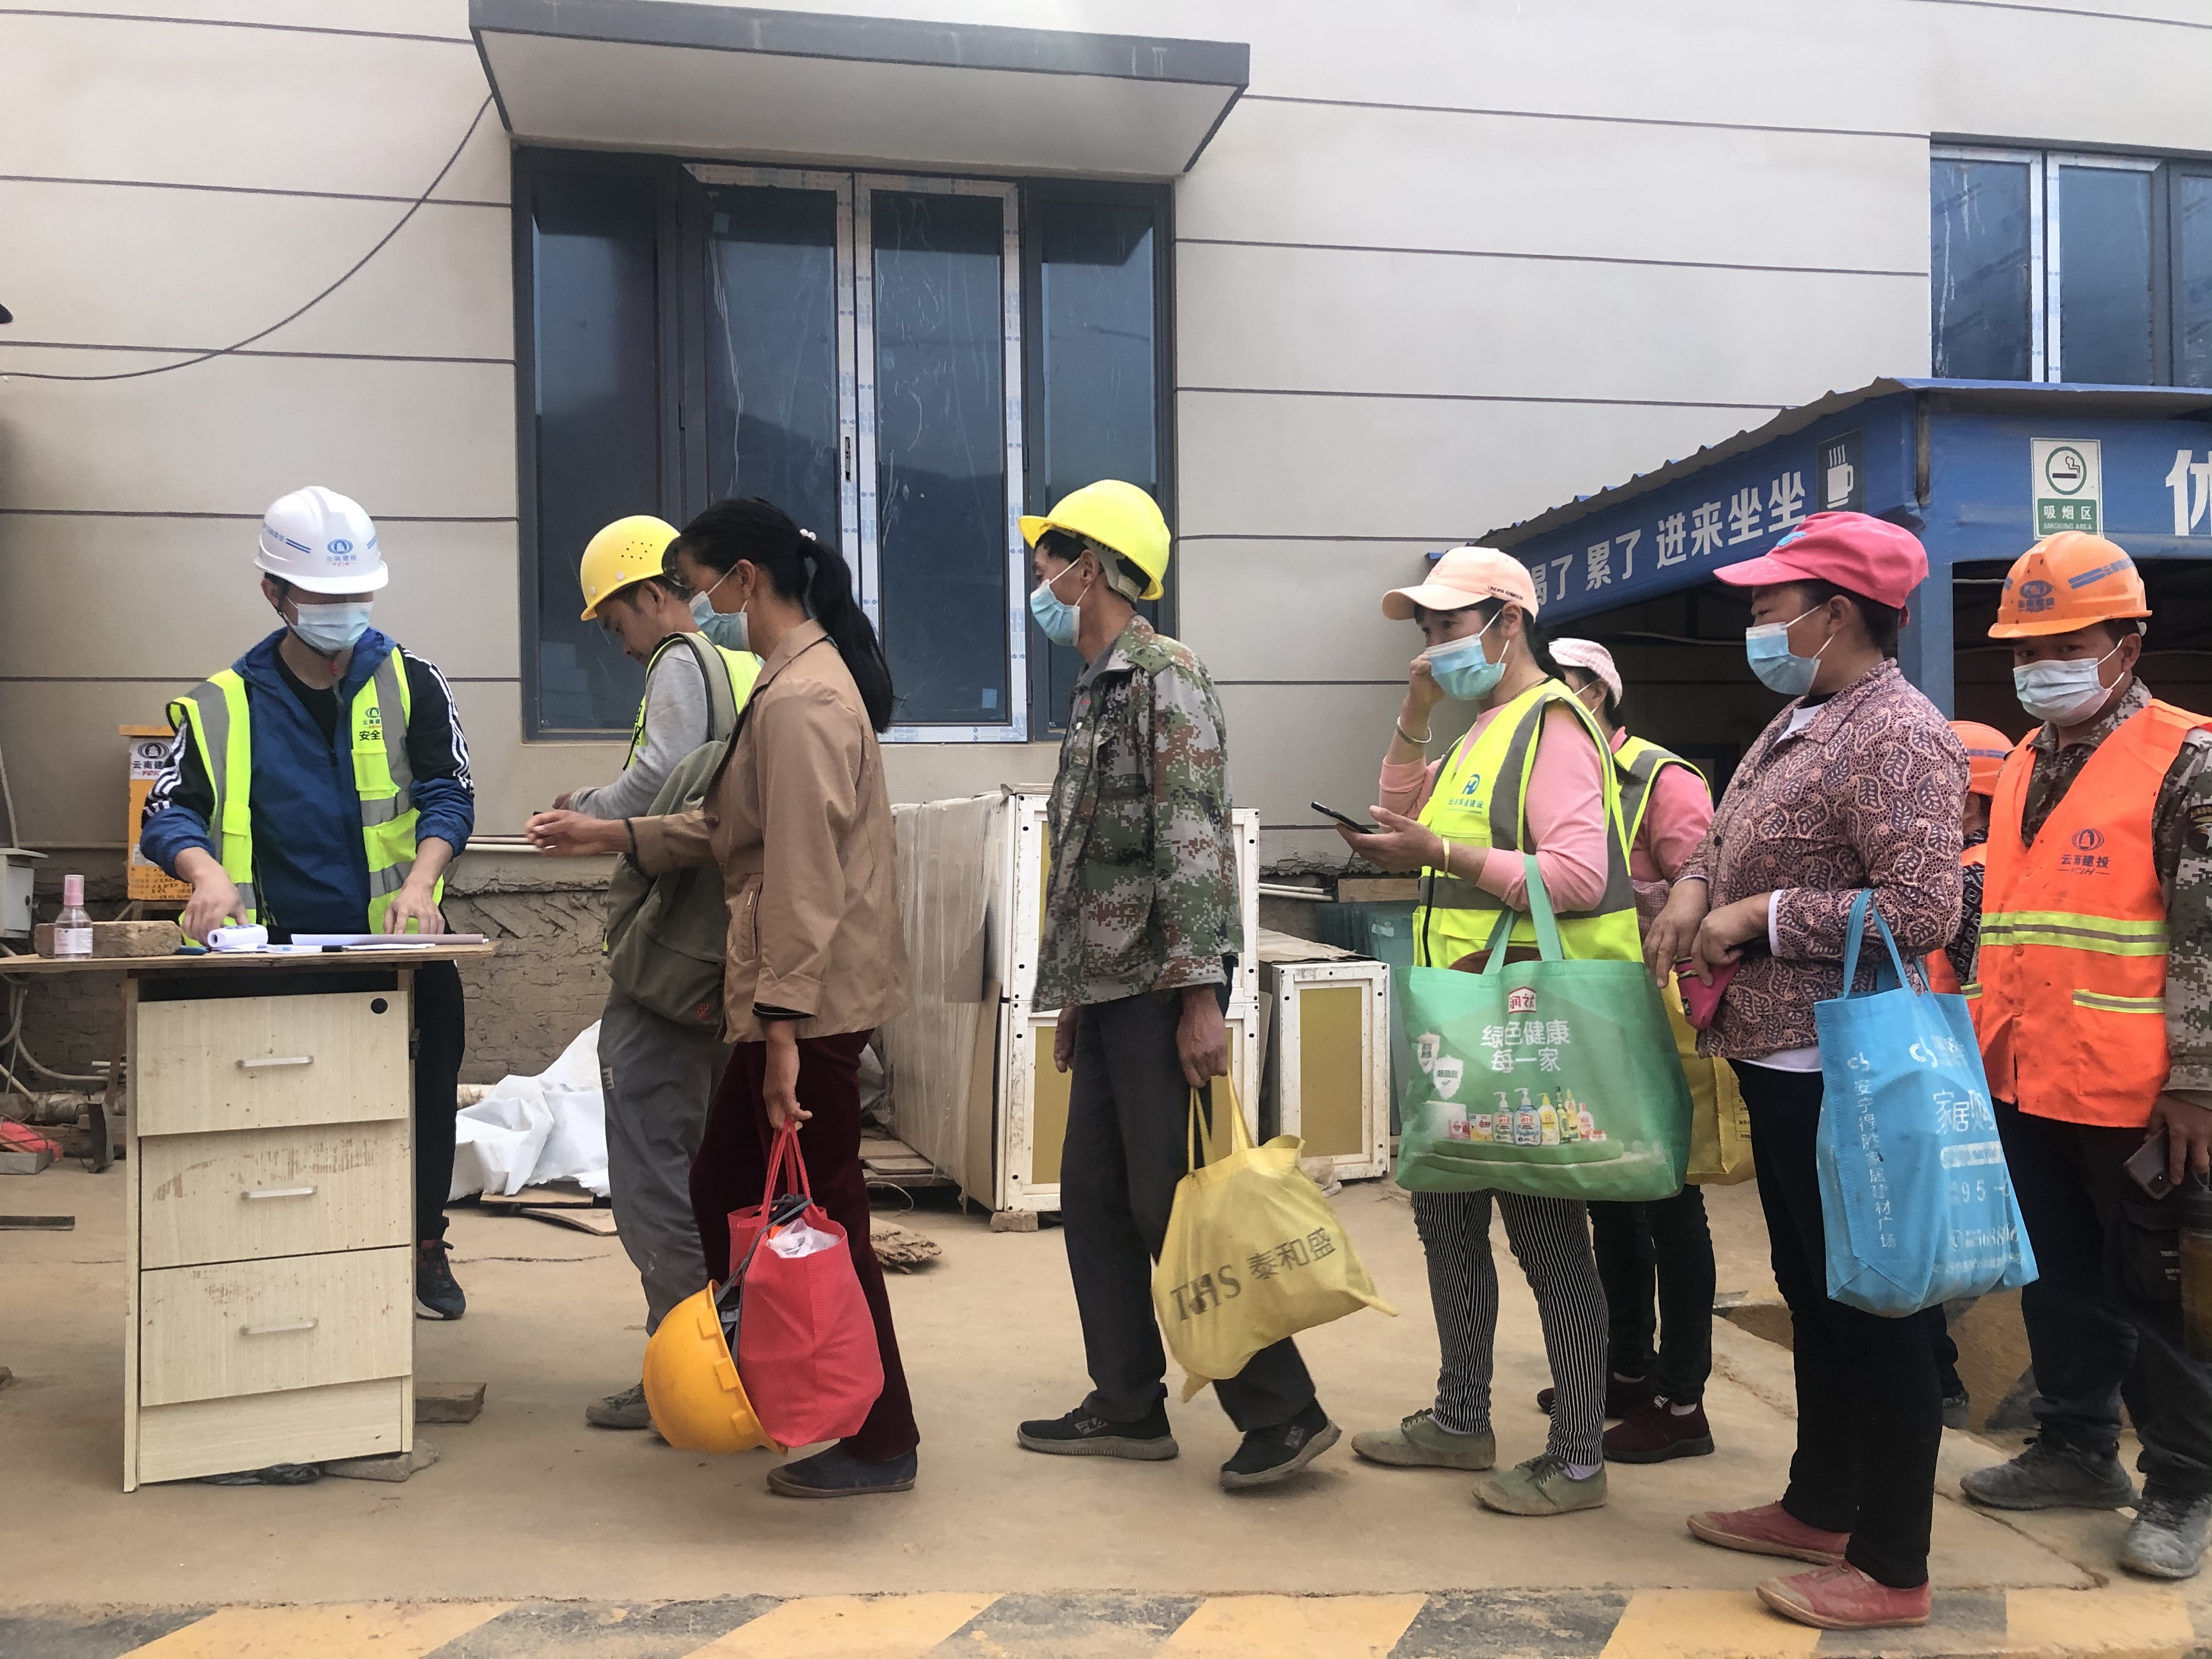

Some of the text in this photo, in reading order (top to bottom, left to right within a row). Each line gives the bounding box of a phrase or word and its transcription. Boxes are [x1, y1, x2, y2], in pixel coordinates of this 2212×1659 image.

[2044, 505, 2092, 520] 吸烟区
[1585, 529, 1642, 591] 累了
[1656, 472, 1806, 570] 进来坐坐
[359, 730, 383, 741] 安全
[2061, 854, 2110, 869] 云南建投
[1481, 1019, 1571, 1048] 绿色健康
[1491, 1047, 1561, 1073] 每一家
[1248, 1227, 1336, 1280] 泰和盛
[1170, 1264, 1242, 1321] THS
